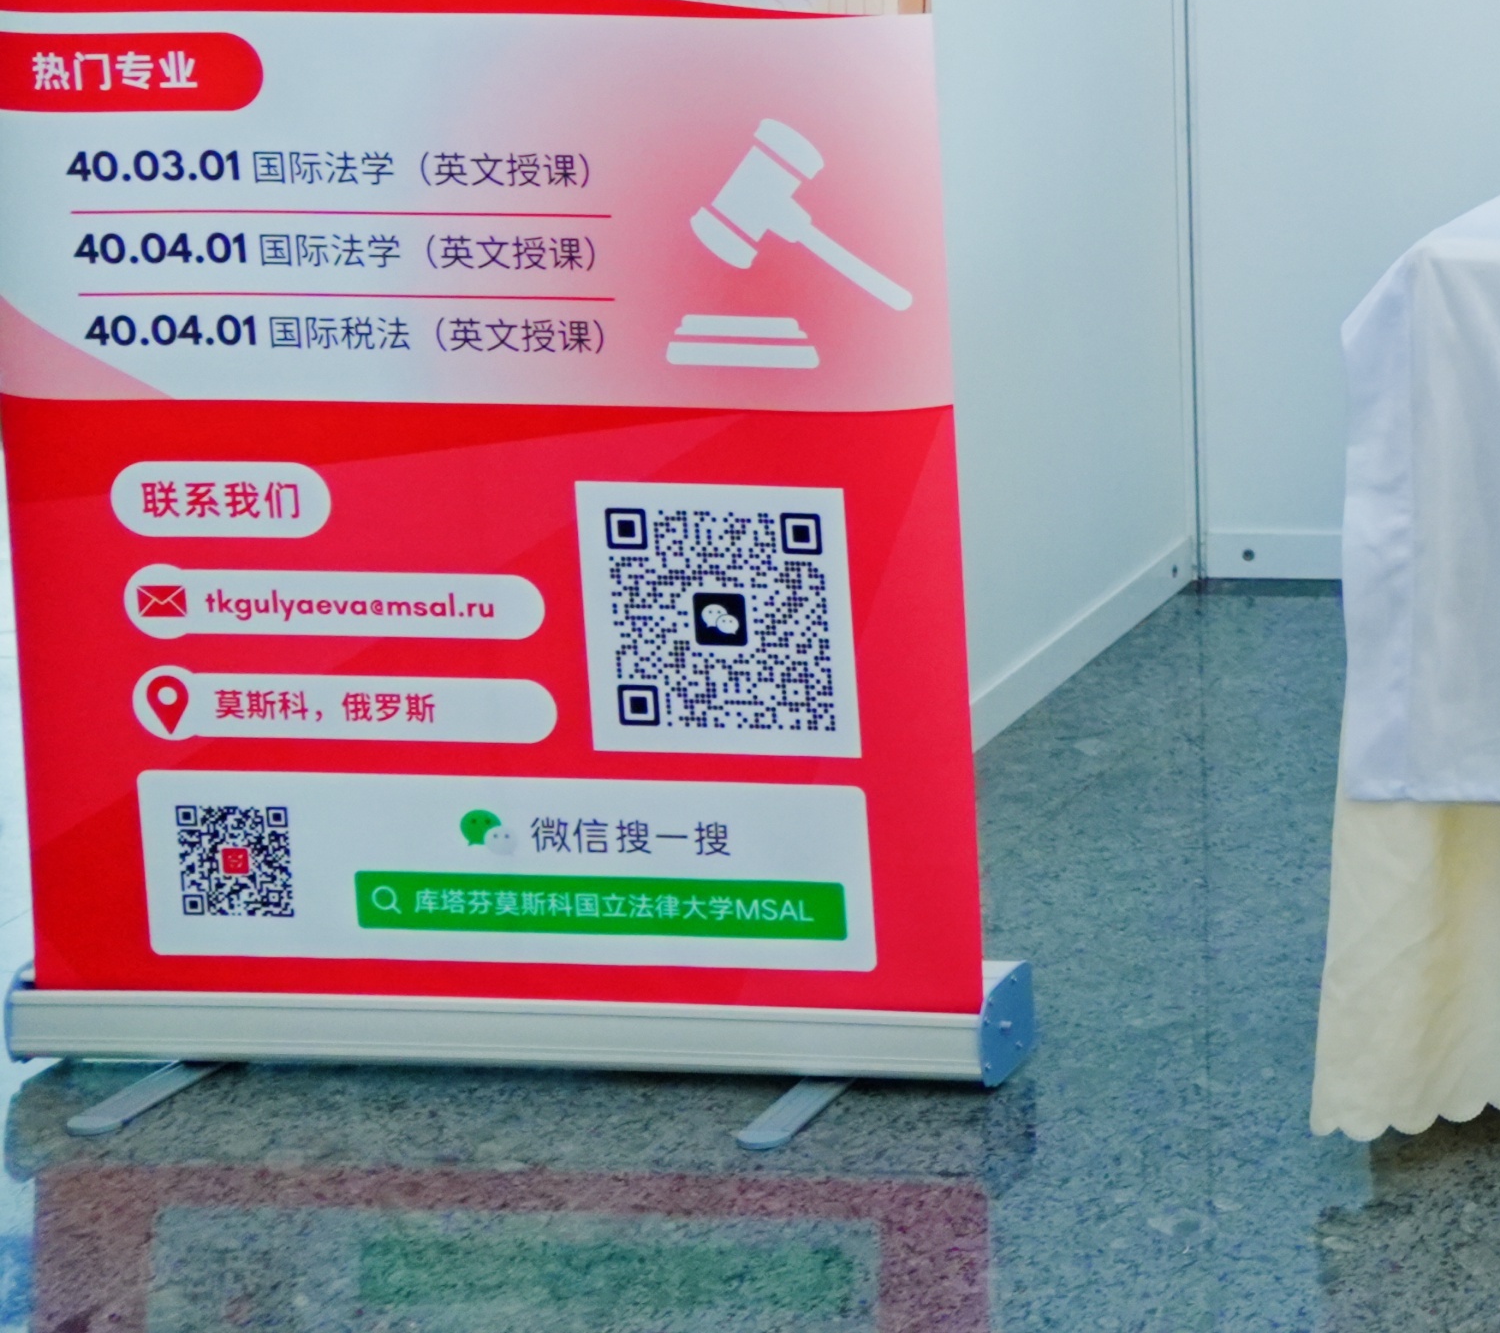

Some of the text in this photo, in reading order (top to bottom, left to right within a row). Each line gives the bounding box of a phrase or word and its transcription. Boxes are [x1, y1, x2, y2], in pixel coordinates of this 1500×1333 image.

[31, 52, 199, 91] 热门专业
[67, 150, 240, 183] 40.03.01
[74, 232, 248, 265] 40.04.01
[85, 315, 258, 348] 40.04.01
[141, 482, 301, 520] 联系我们
[205, 589, 496, 623] tkgulyaeva@msal.ru
[530, 816, 730, 858] 微信搜一搜
[413, 889, 814, 924] 库塔芬莫斯科国立法律大学MSAL
